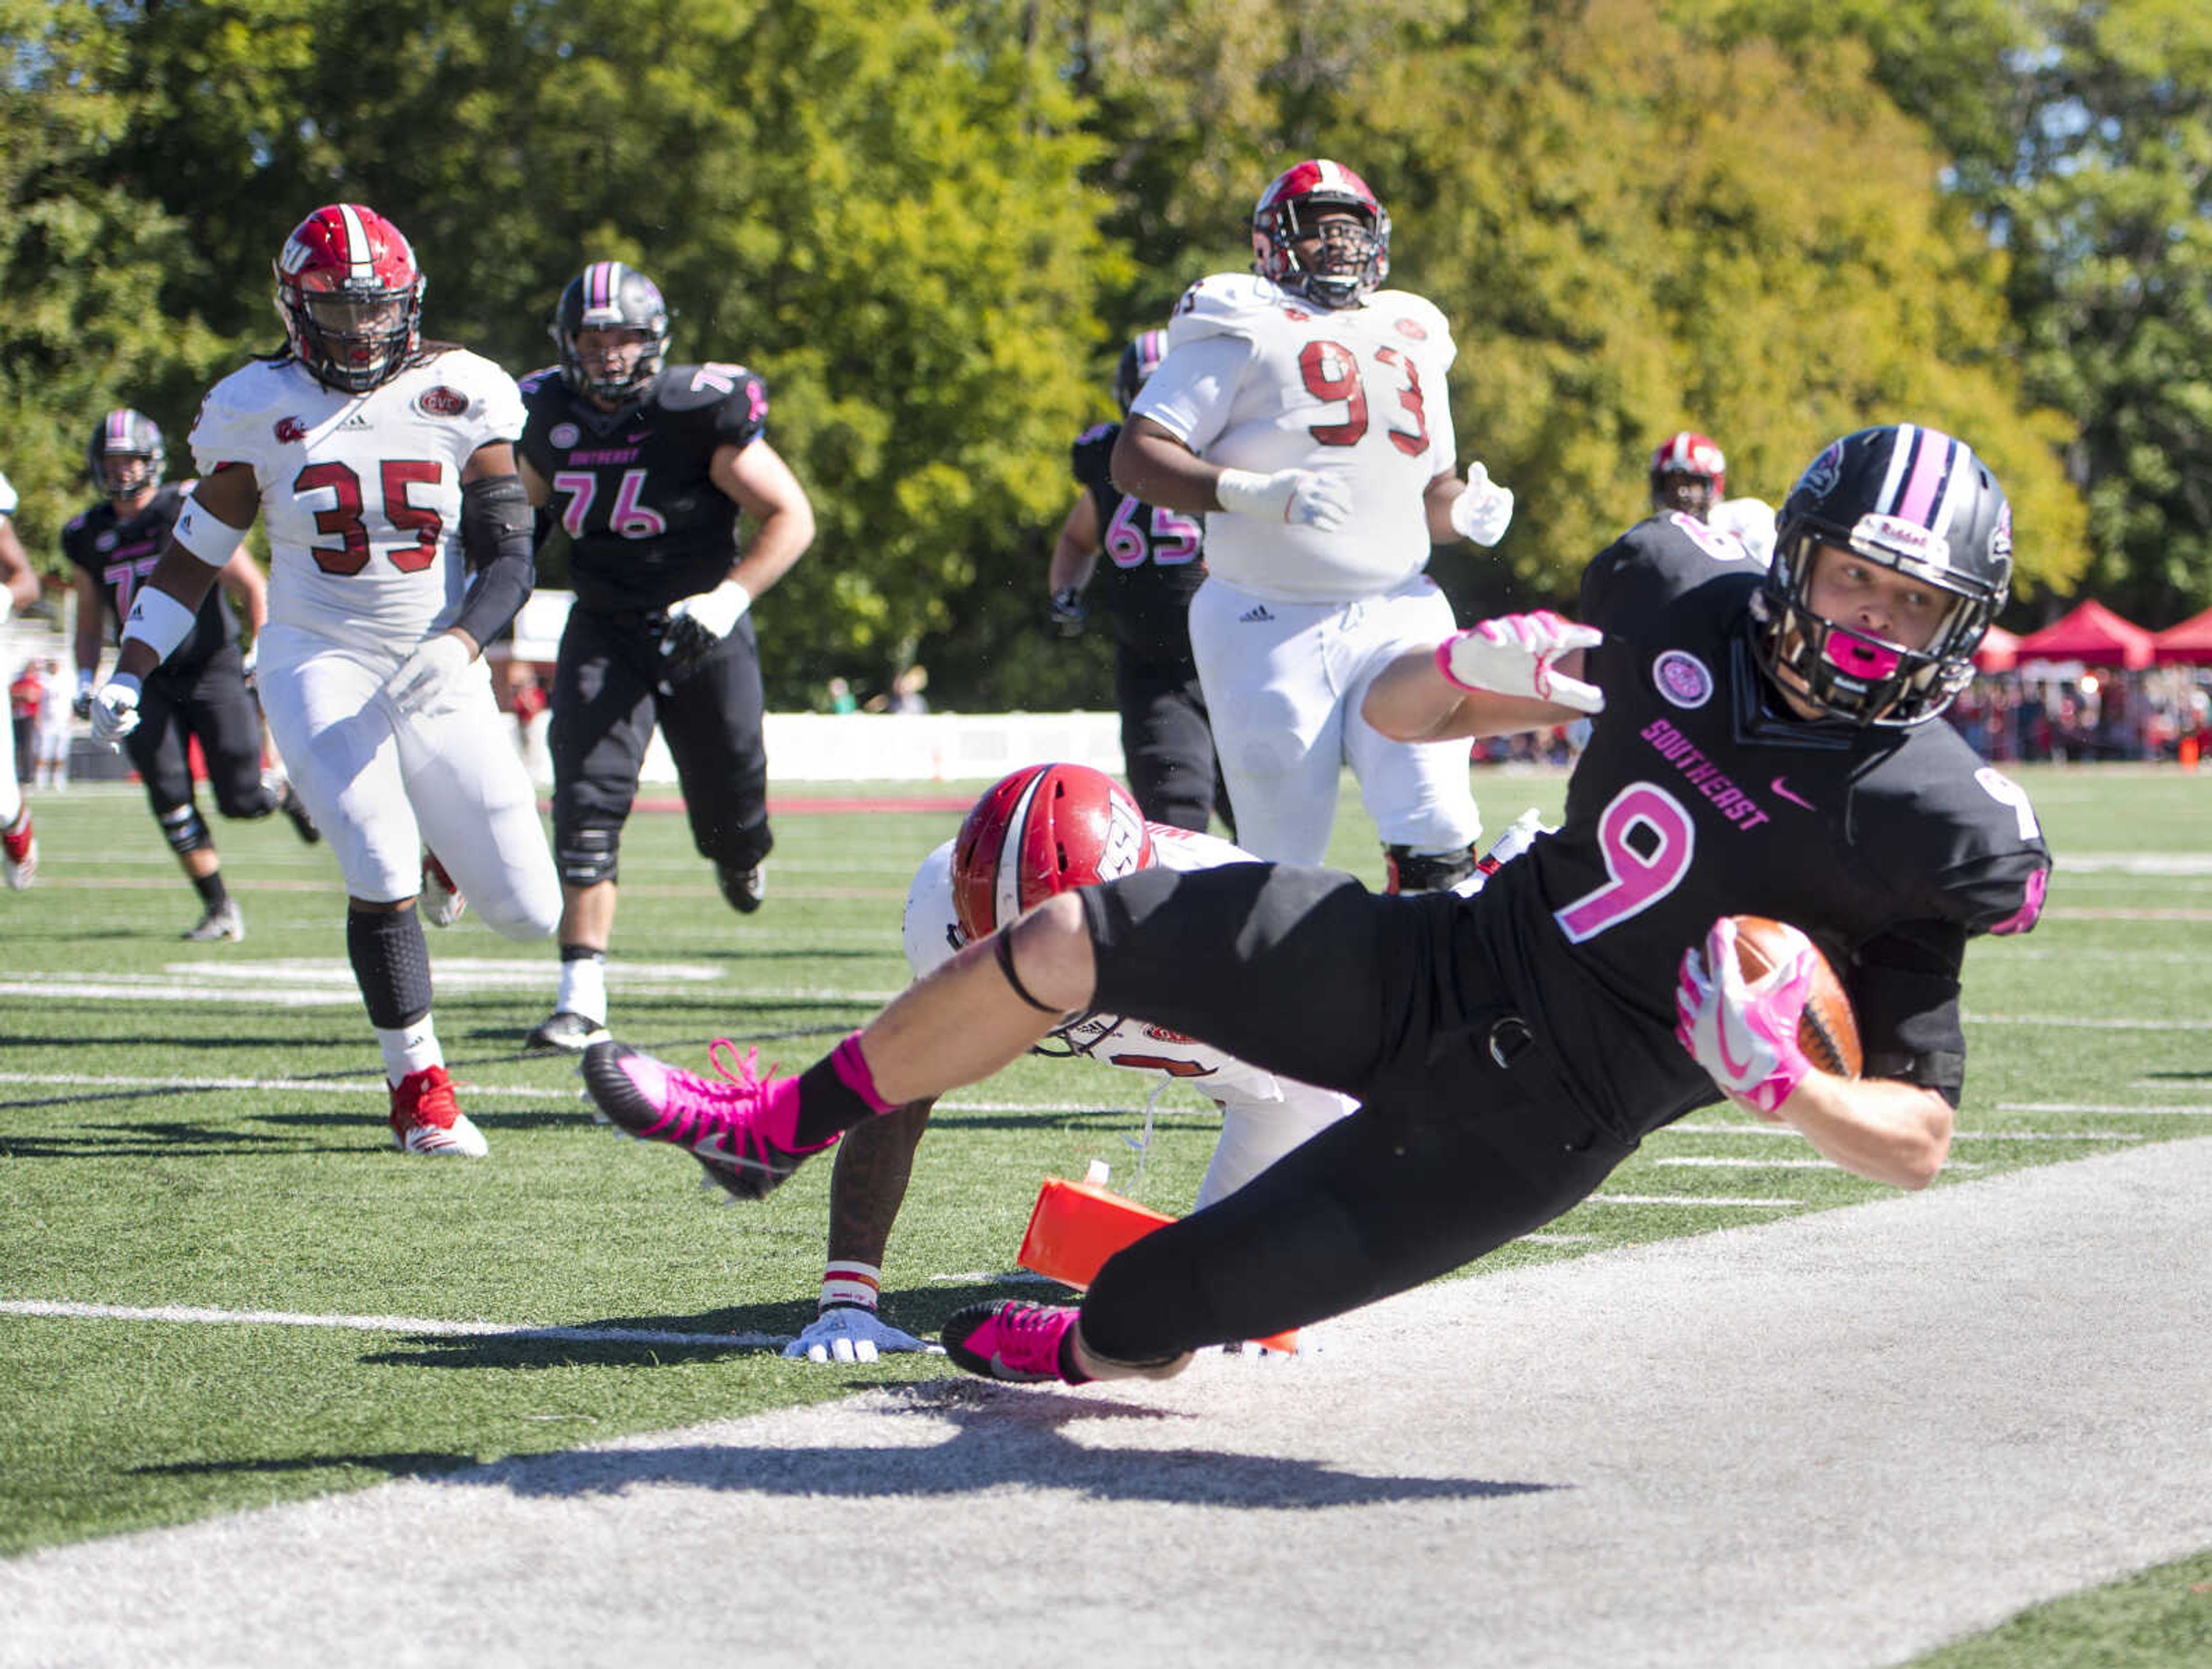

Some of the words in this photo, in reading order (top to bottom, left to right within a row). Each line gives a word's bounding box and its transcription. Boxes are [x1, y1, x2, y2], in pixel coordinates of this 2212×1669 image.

[1298, 340, 1429, 457] 93
[293, 460, 443, 576] 35
[554, 468, 666, 540] 76
[1105, 492, 1203, 568] 65
[1640, 718, 1770, 831] SOUTHEAST
[1974, 767, 2040, 840] 9
[1554, 781, 1695, 944] 9
